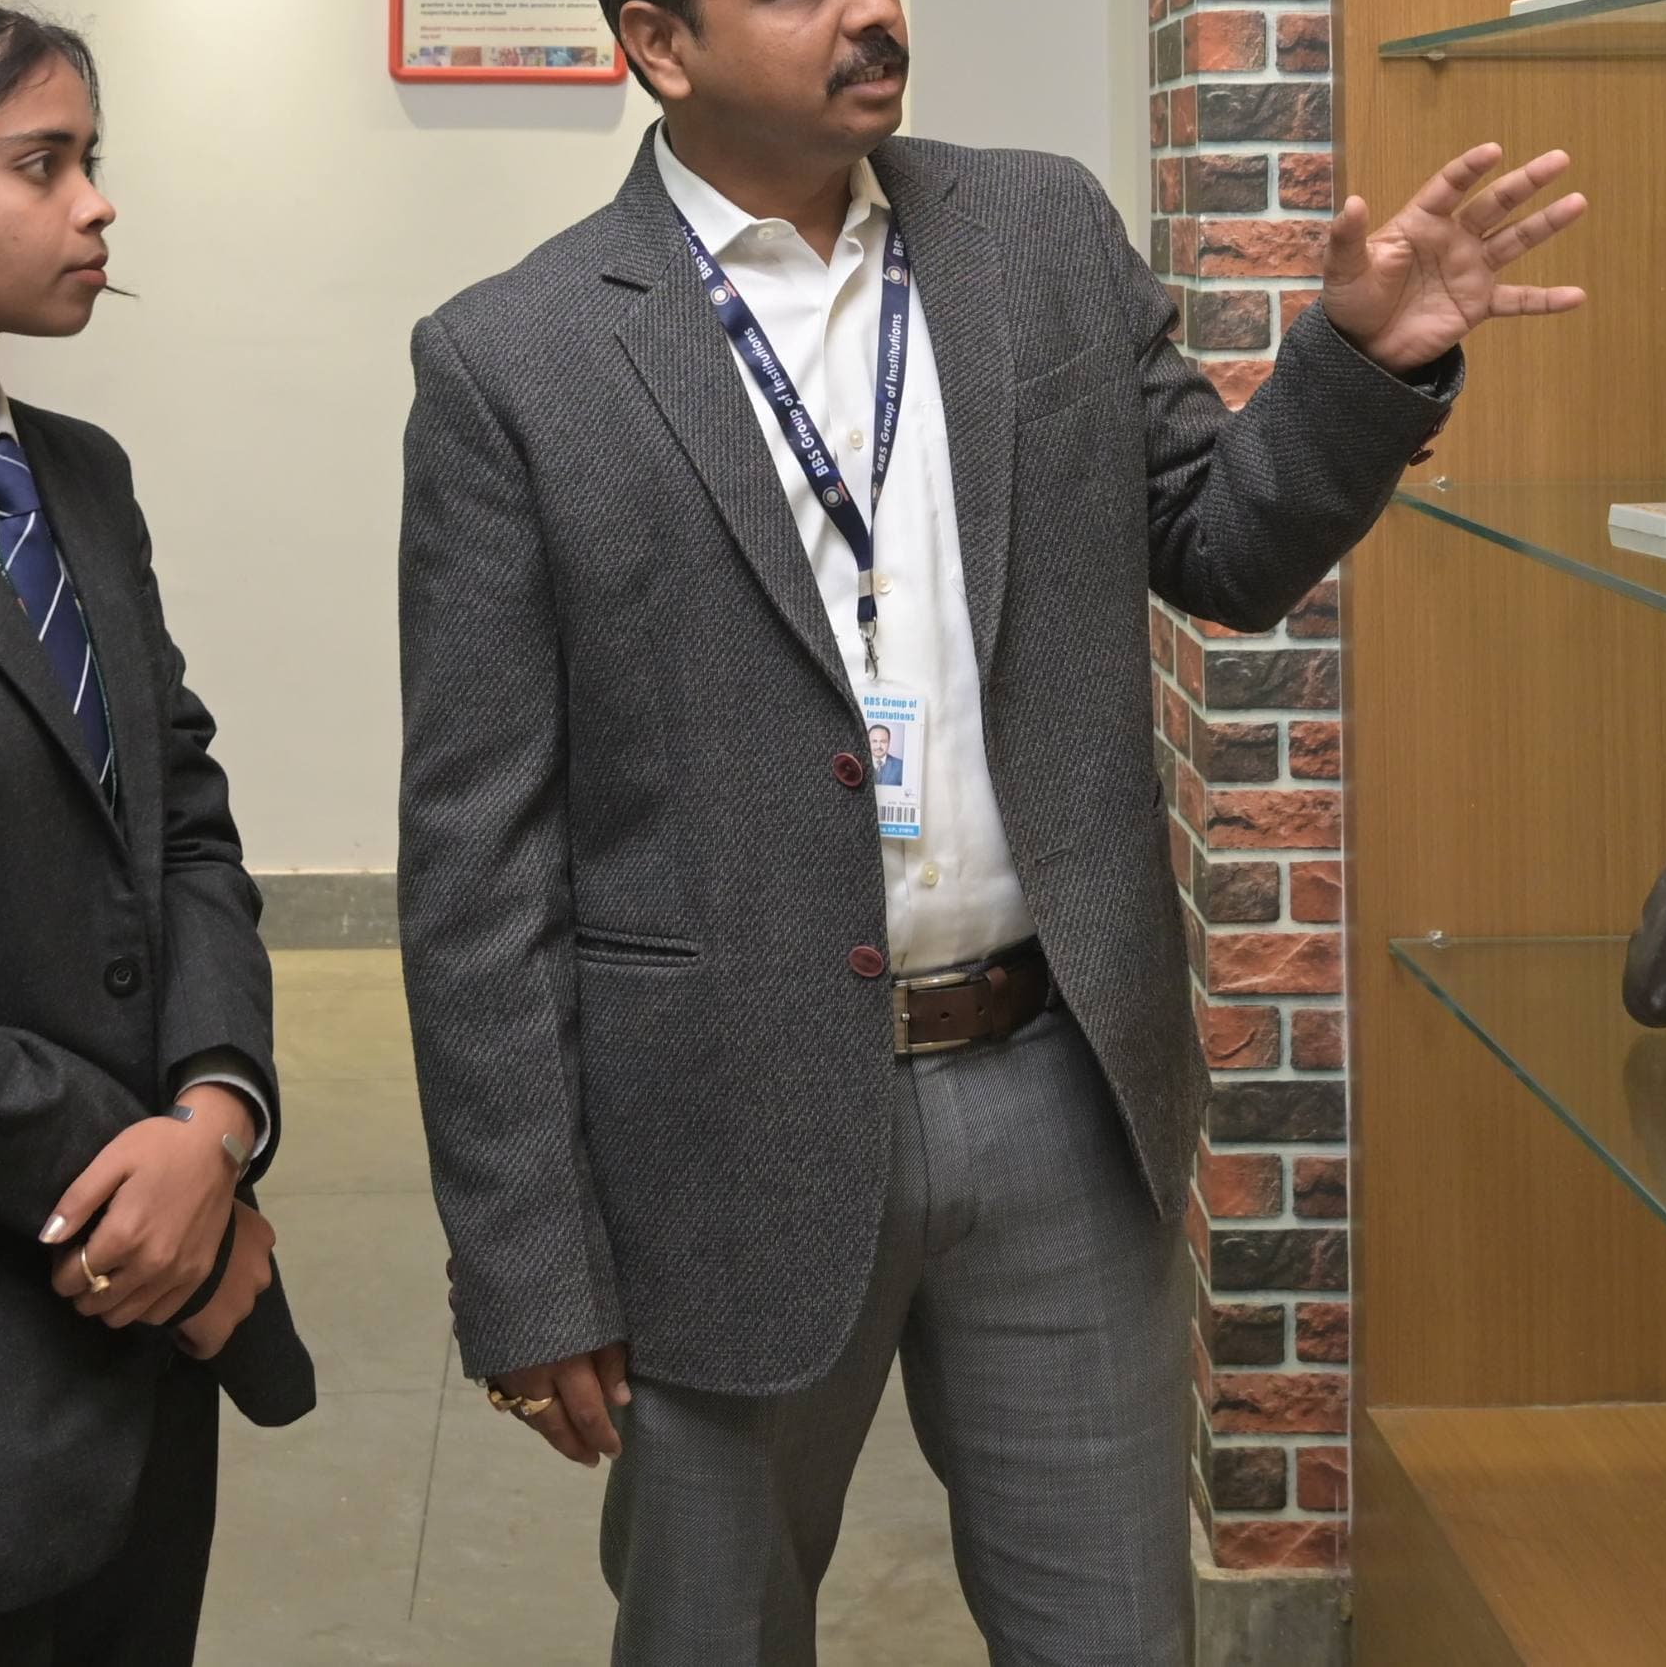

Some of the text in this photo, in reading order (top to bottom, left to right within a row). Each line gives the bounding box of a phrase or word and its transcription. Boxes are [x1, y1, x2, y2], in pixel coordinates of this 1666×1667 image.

[696, 255, 714, 280] BBS
[744, 327, 830, 478] BBS Group of Institutions
[876, 313, 903, 472] BBS Group of Institutions
[863, 696, 917, 709] BBS Group of
[866, 709, 916, 722] Institutions
